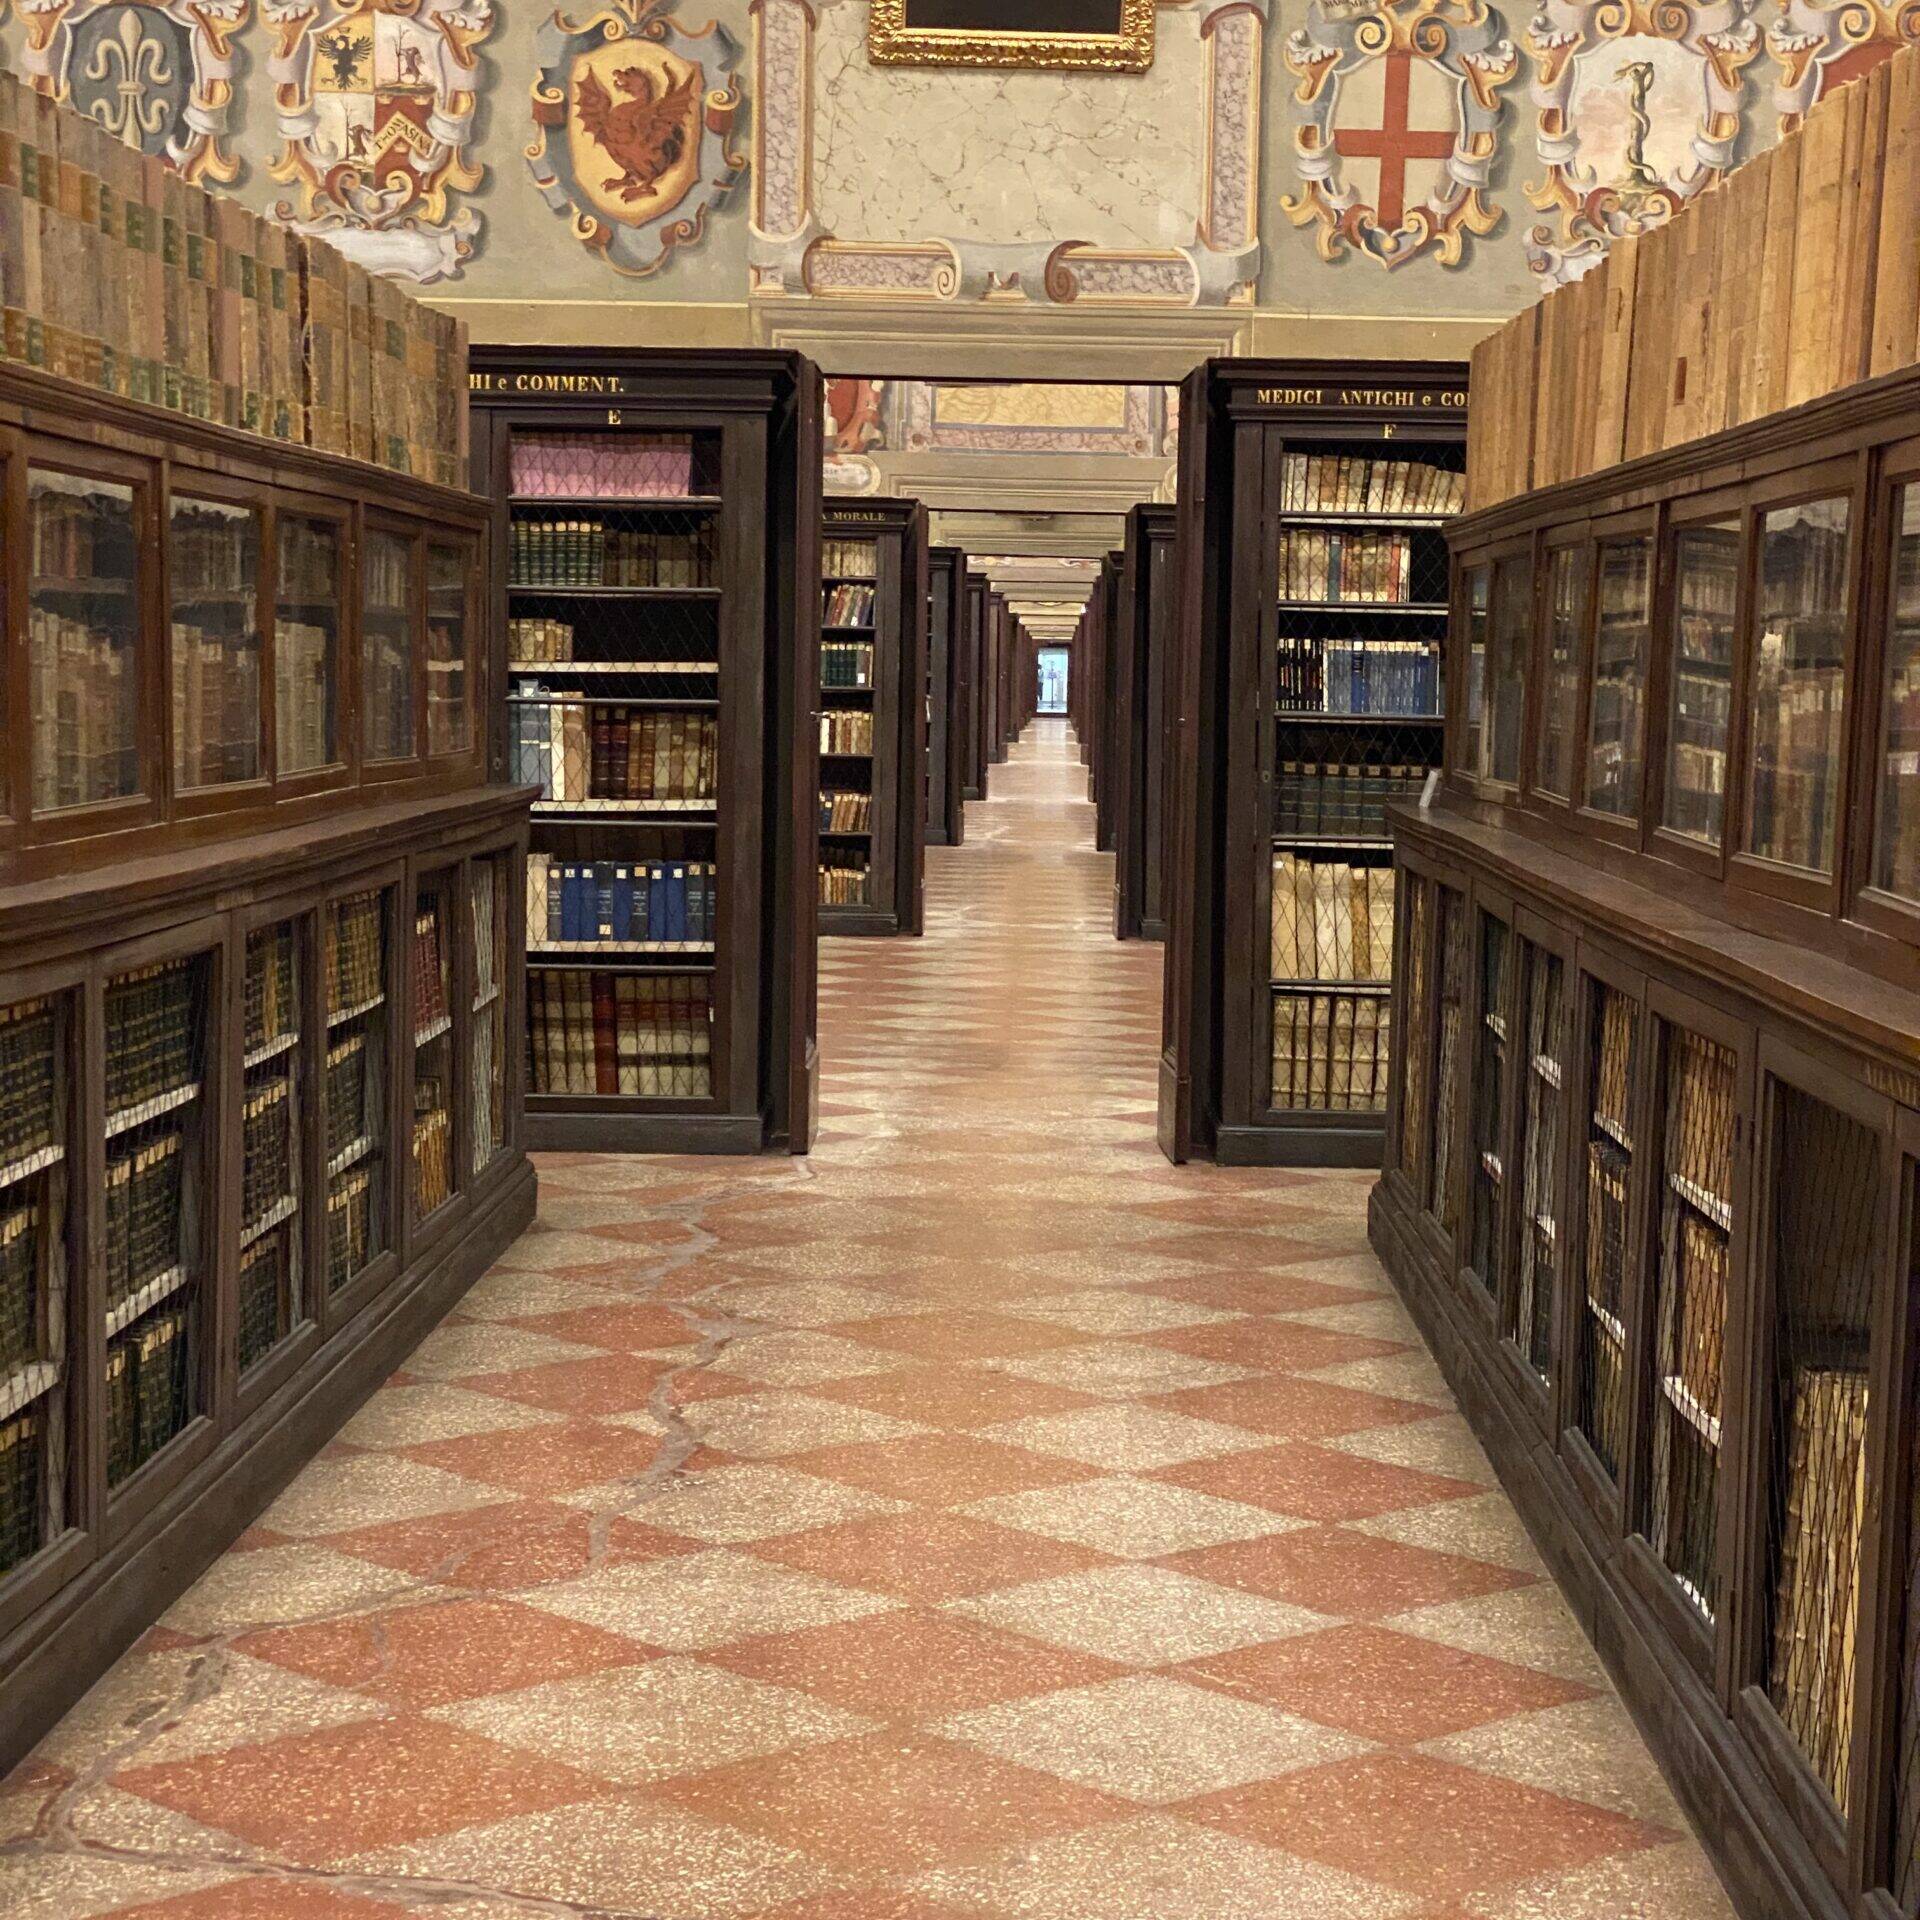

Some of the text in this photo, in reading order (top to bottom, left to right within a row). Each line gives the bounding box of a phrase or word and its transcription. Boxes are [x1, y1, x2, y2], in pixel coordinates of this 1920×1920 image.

[498, 378, 507, 389] e
[516, 375, 624, 392] COMMENT.
[1257, 389, 1470, 407] MEDICI ANTICHI e CO
[608, 409, 621, 425] E
[1383, 424, 1397, 439] F
[832, 511, 886, 521] MORALE
